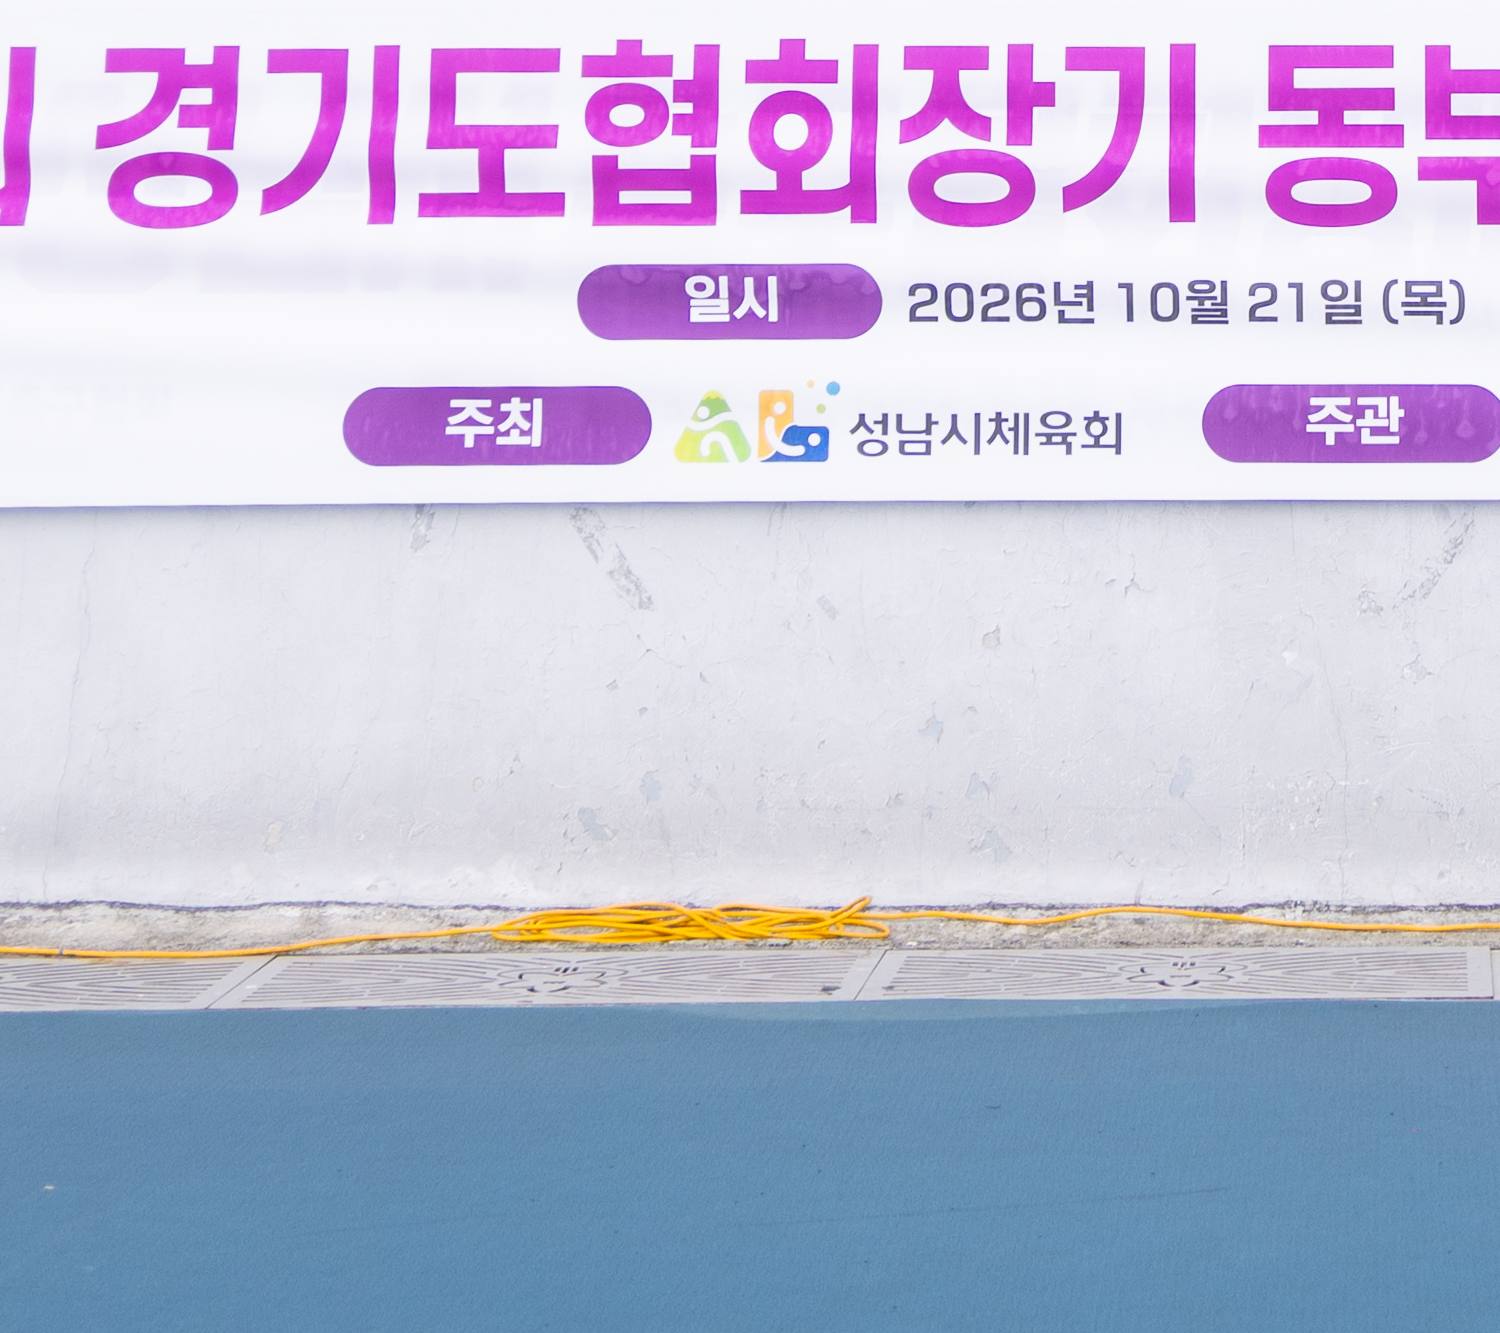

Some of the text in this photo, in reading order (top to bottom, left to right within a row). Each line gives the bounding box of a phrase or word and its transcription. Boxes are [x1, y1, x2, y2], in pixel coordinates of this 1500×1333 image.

[94, 38, 1197, 230] 경기도협회장기
[683, 274, 1467, 329] 일시 2026년 10월 21일 (목)
[443, 396, 1123, 458] 주최 성남시체육회
[1306, 396, 1405, 446] 주관
